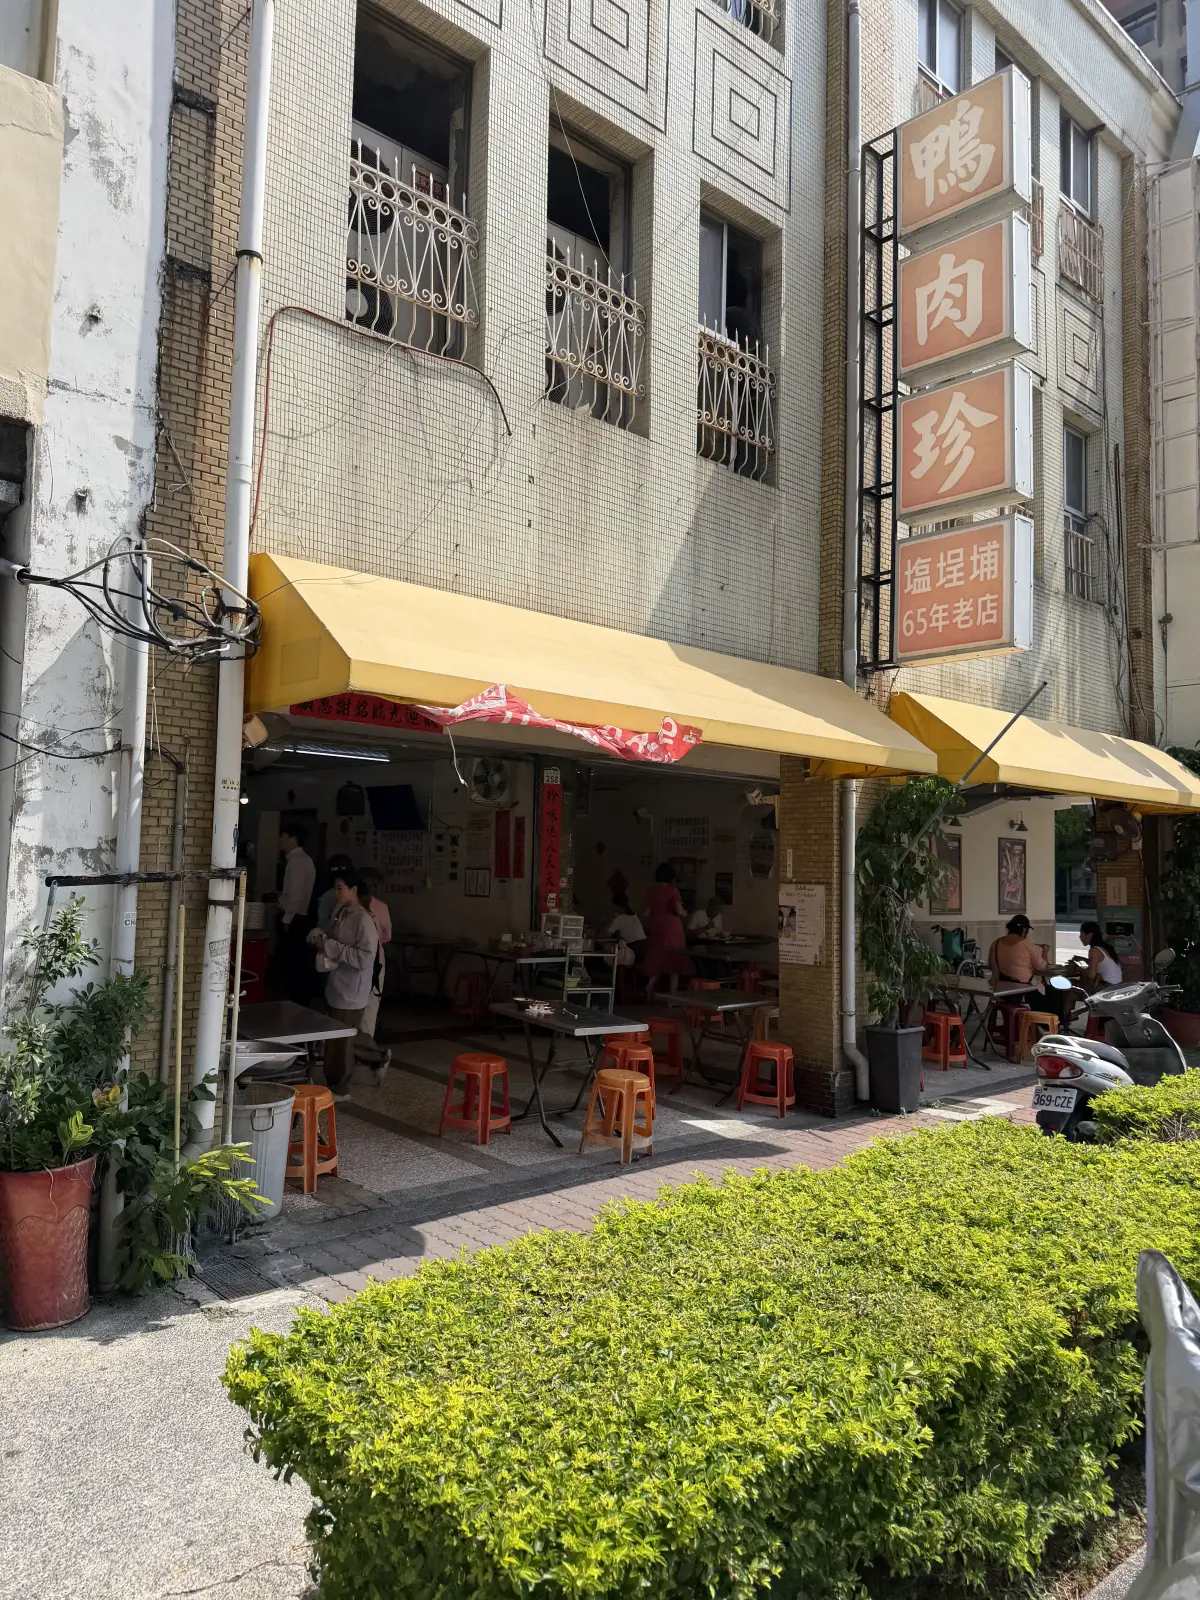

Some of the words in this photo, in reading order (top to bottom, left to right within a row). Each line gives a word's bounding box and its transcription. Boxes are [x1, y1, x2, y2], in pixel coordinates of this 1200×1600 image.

[910, 99, 998, 493] 鴨肉珍
[904, 540, 1000, 595] 塩埕埔
[903, 593, 998, 637] 65年老店
[546, 775, 559, 784] 258
[1034, 1094, 1073, 1109] 369-CZE
